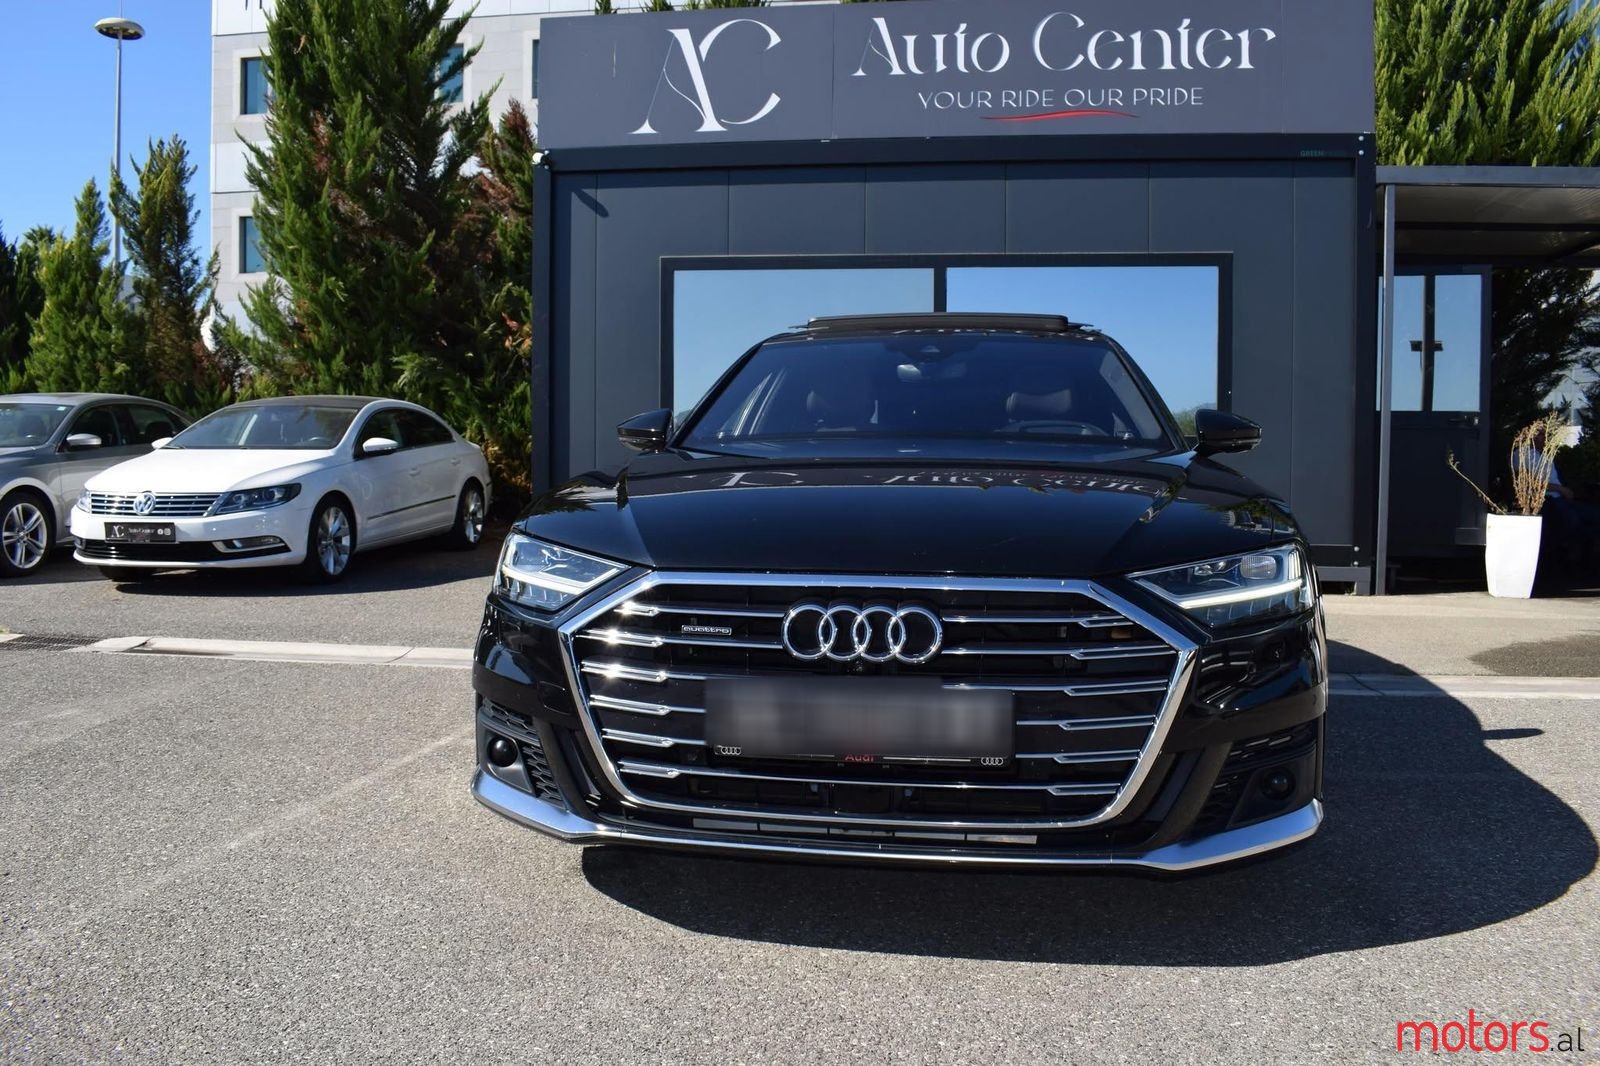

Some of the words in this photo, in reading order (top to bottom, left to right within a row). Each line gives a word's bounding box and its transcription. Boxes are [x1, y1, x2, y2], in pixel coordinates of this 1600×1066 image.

[850, 17, 1010, 76] Auto
[1032, 11, 1277, 72] Center
[918, 90, 993, 110] YOUR
[1001, 89, 1055, 108] RIDE
[1064, 88, 1124, 107] OUR
[1133, 87, 1205, 106] PRIDE
[682, 626, 730, 634] quattro
[844, 753, 874, 763] Audi
